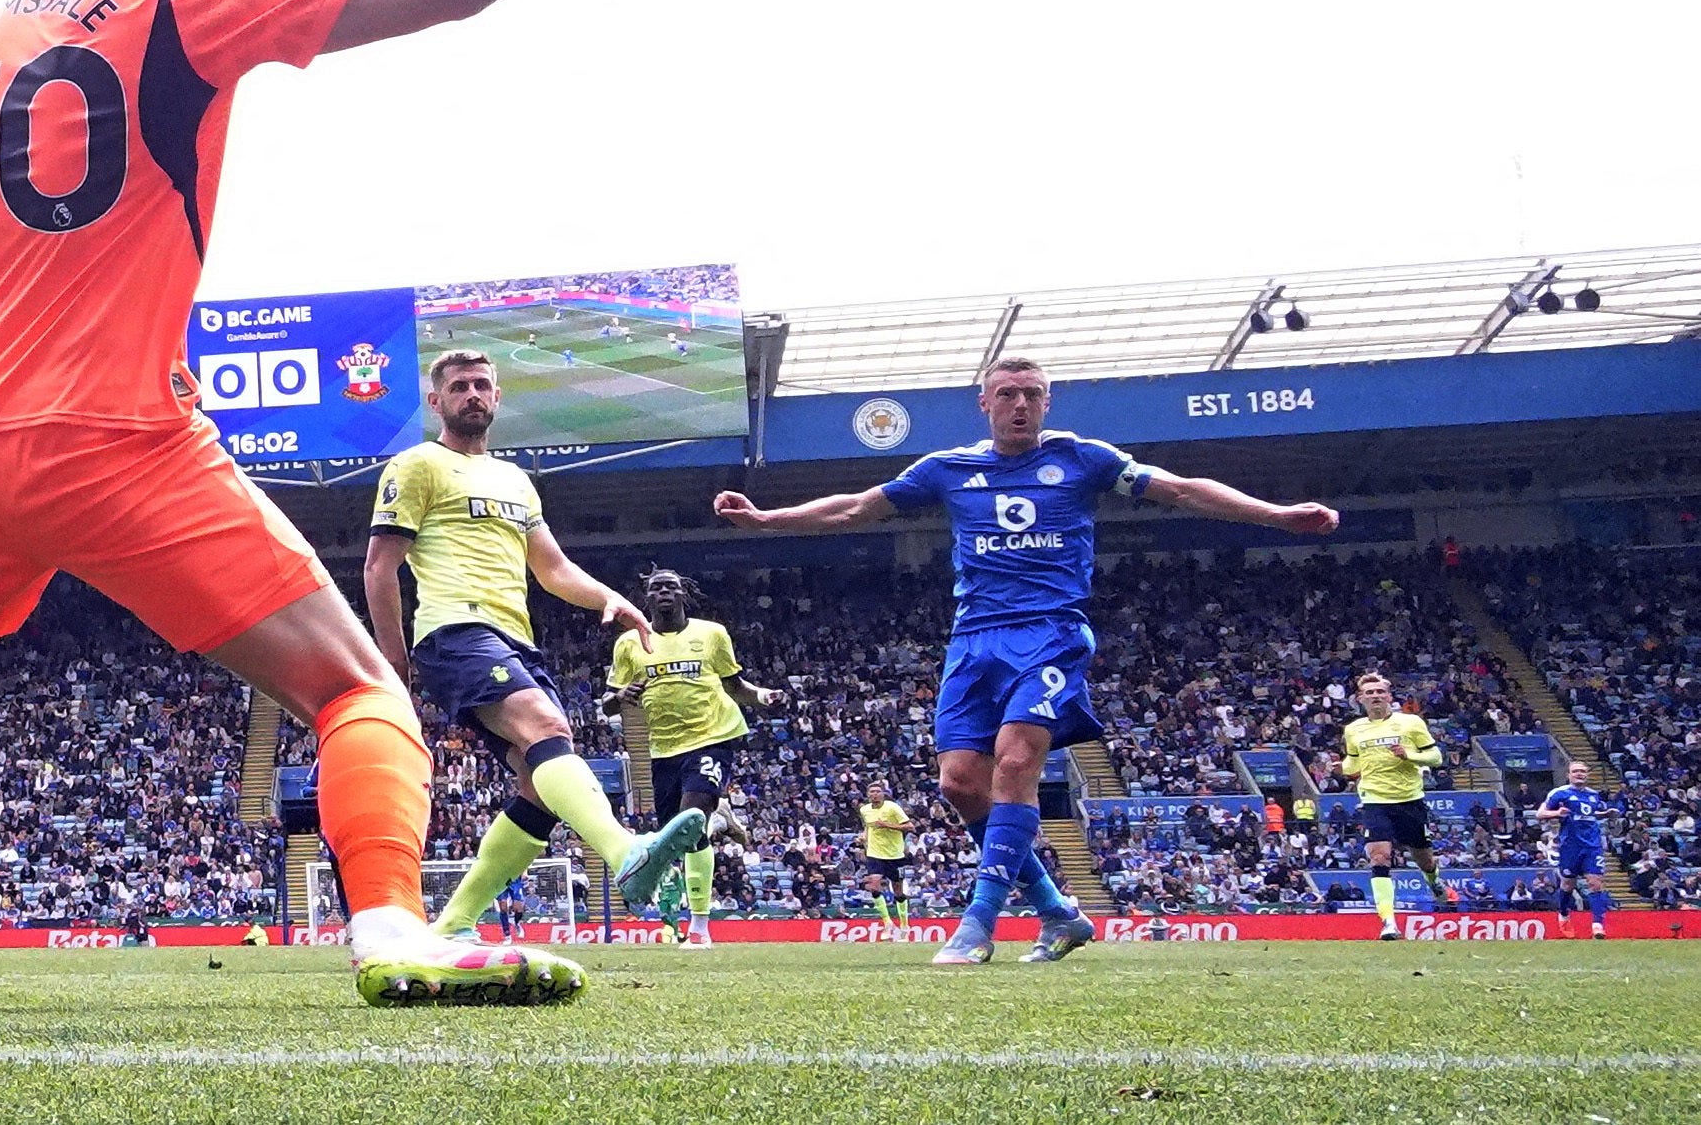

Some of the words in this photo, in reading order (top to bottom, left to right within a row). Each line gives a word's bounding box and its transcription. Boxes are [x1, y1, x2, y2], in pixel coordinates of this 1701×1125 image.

[226, 306, 312, 327] BC.GAME
[1187, 393, 1240, 417] EST.
[1246, 387, 1315, 413] 1884
[228, 431, 299, 455] 16:02
[975, 532, 1065, 555] BC.GAME
[646, 660, 701, 678] ROLLBIT
[1041, 666, 1067, 699] 9
[1426, 799, 1455, 811] WER
[49, 930, 157, 948] Beta
[292, 928, 347, 946] Bet
[1105, 918, 1238, 941] Beano
[1405, 915, 1545, 940] Betano
